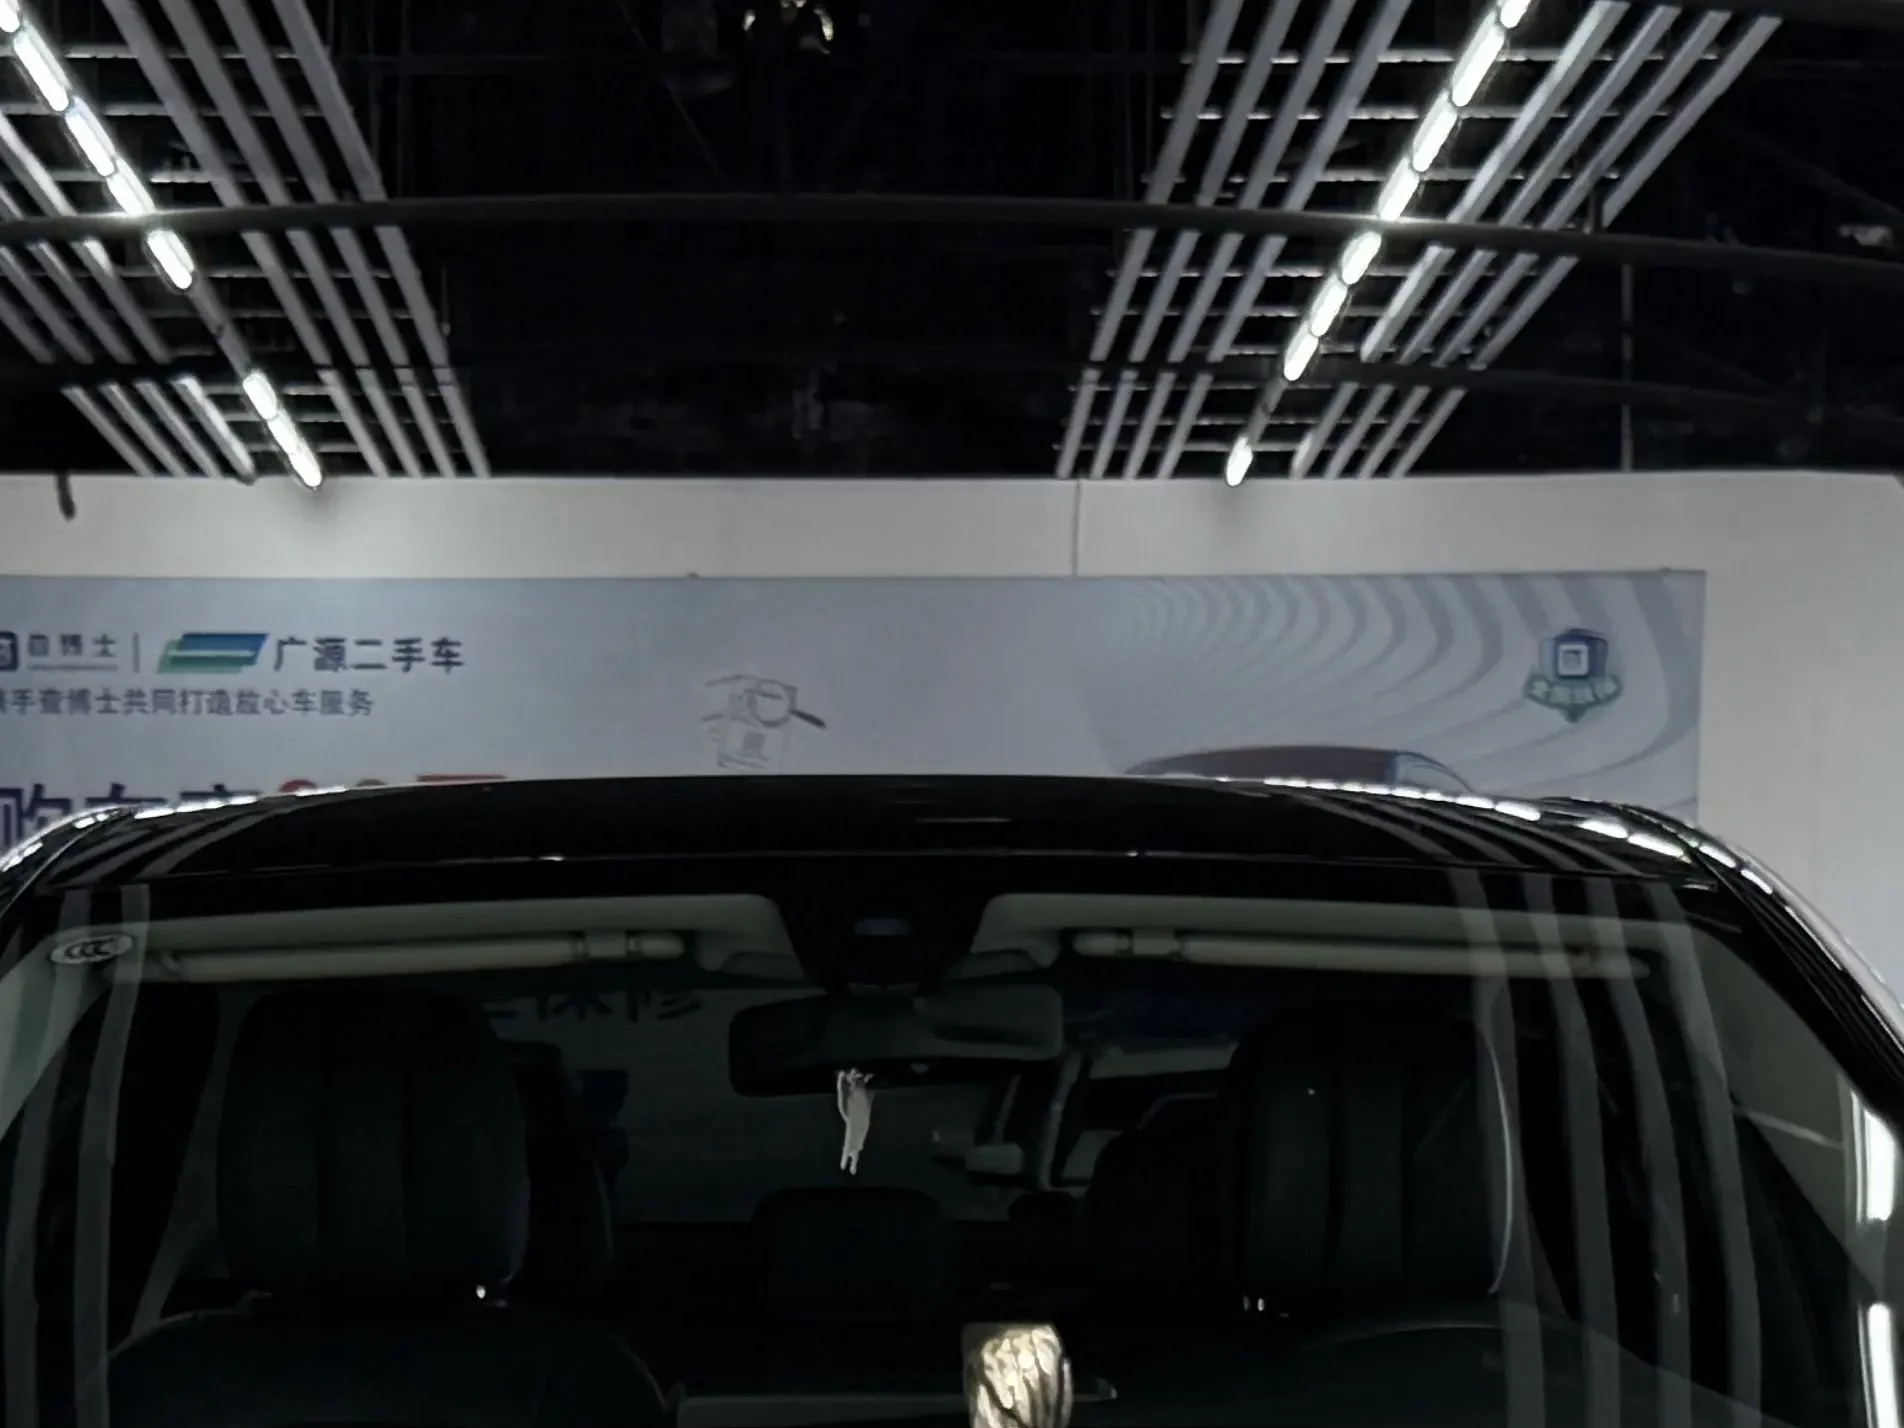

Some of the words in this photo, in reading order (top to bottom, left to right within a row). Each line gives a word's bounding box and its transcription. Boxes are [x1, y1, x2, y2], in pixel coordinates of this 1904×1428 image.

[274, 636, 466, 672] 广源二手车
